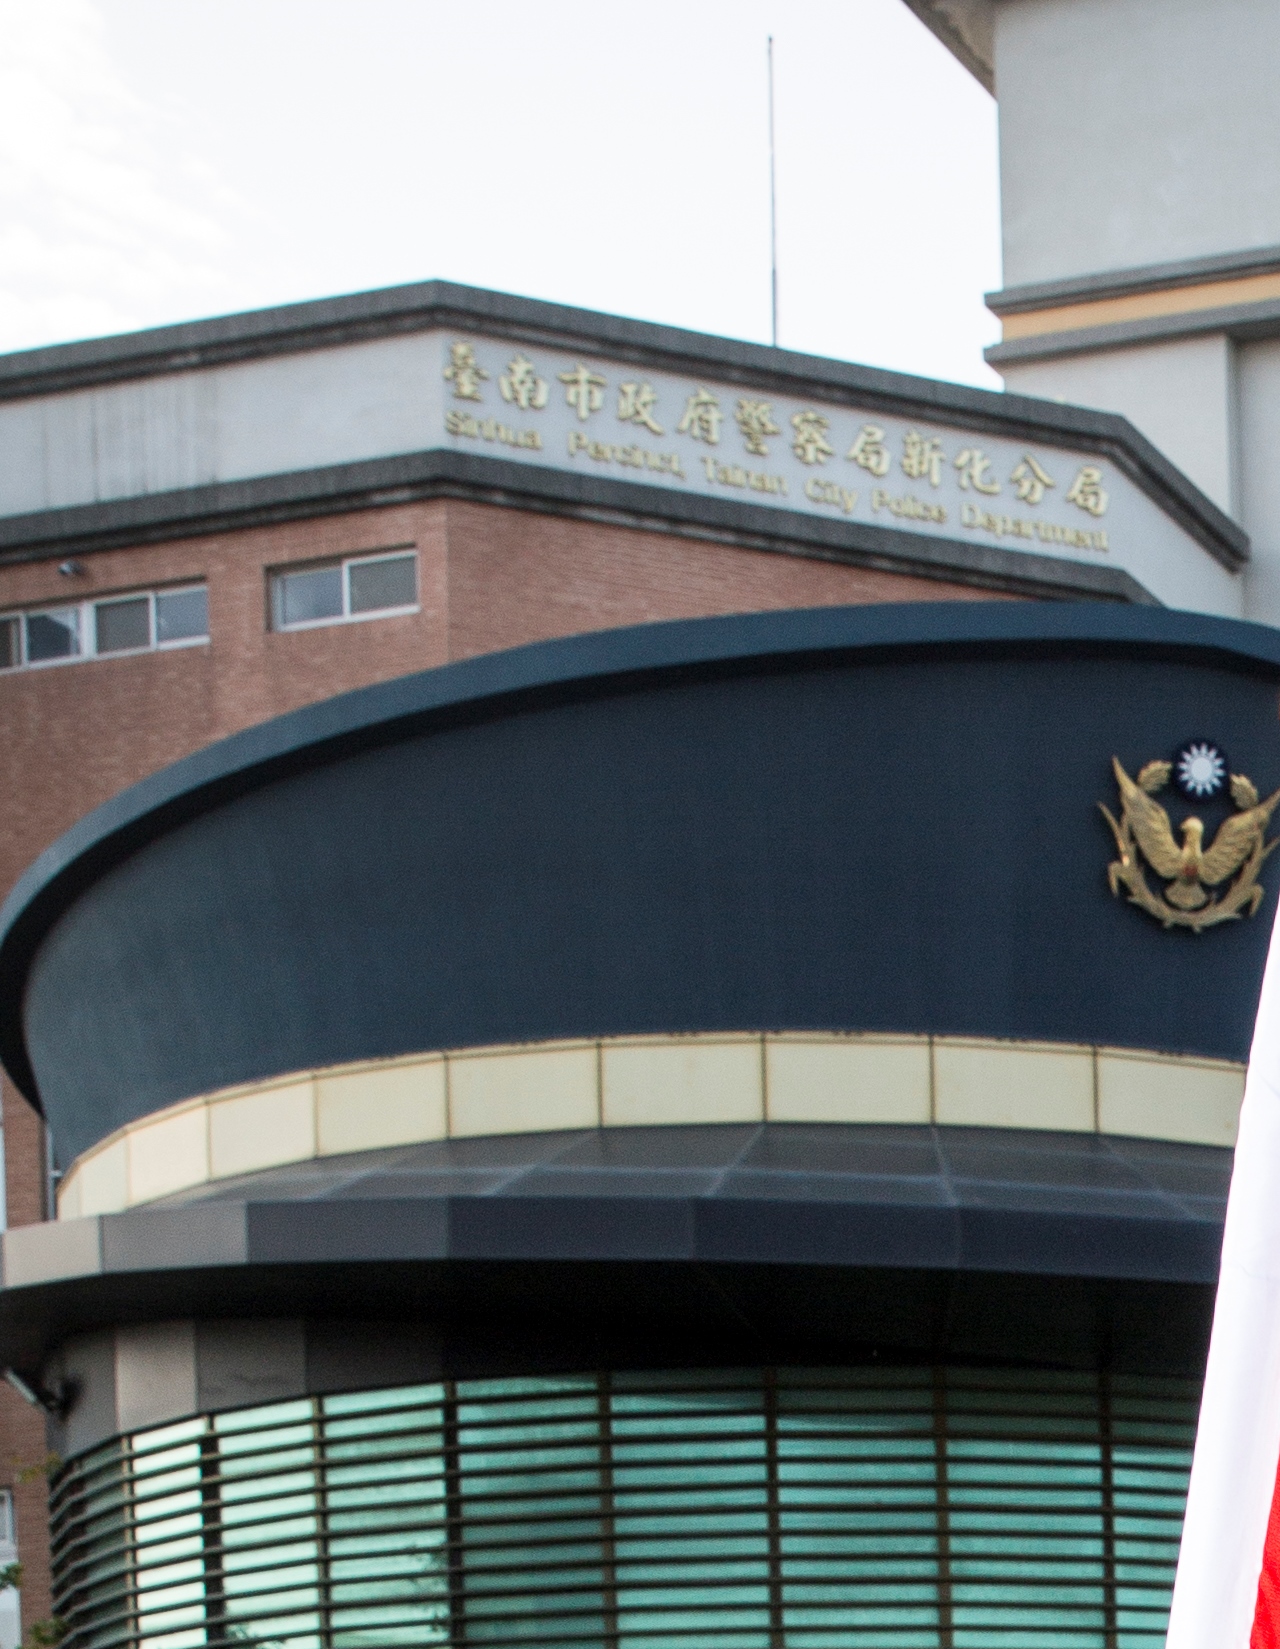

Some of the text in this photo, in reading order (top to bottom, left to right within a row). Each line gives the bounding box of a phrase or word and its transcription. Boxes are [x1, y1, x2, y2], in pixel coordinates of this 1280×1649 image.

[443, 340, 1110, 518] 臺南市政府警察局新化分局
[445, 410, 542, 451] Sinhua
[702, 456, 788, 496] Tainan
[804, 477, 859, 513] City
[871, 487, 947, 524] Police
[961, 503, 1109, 552] Department
